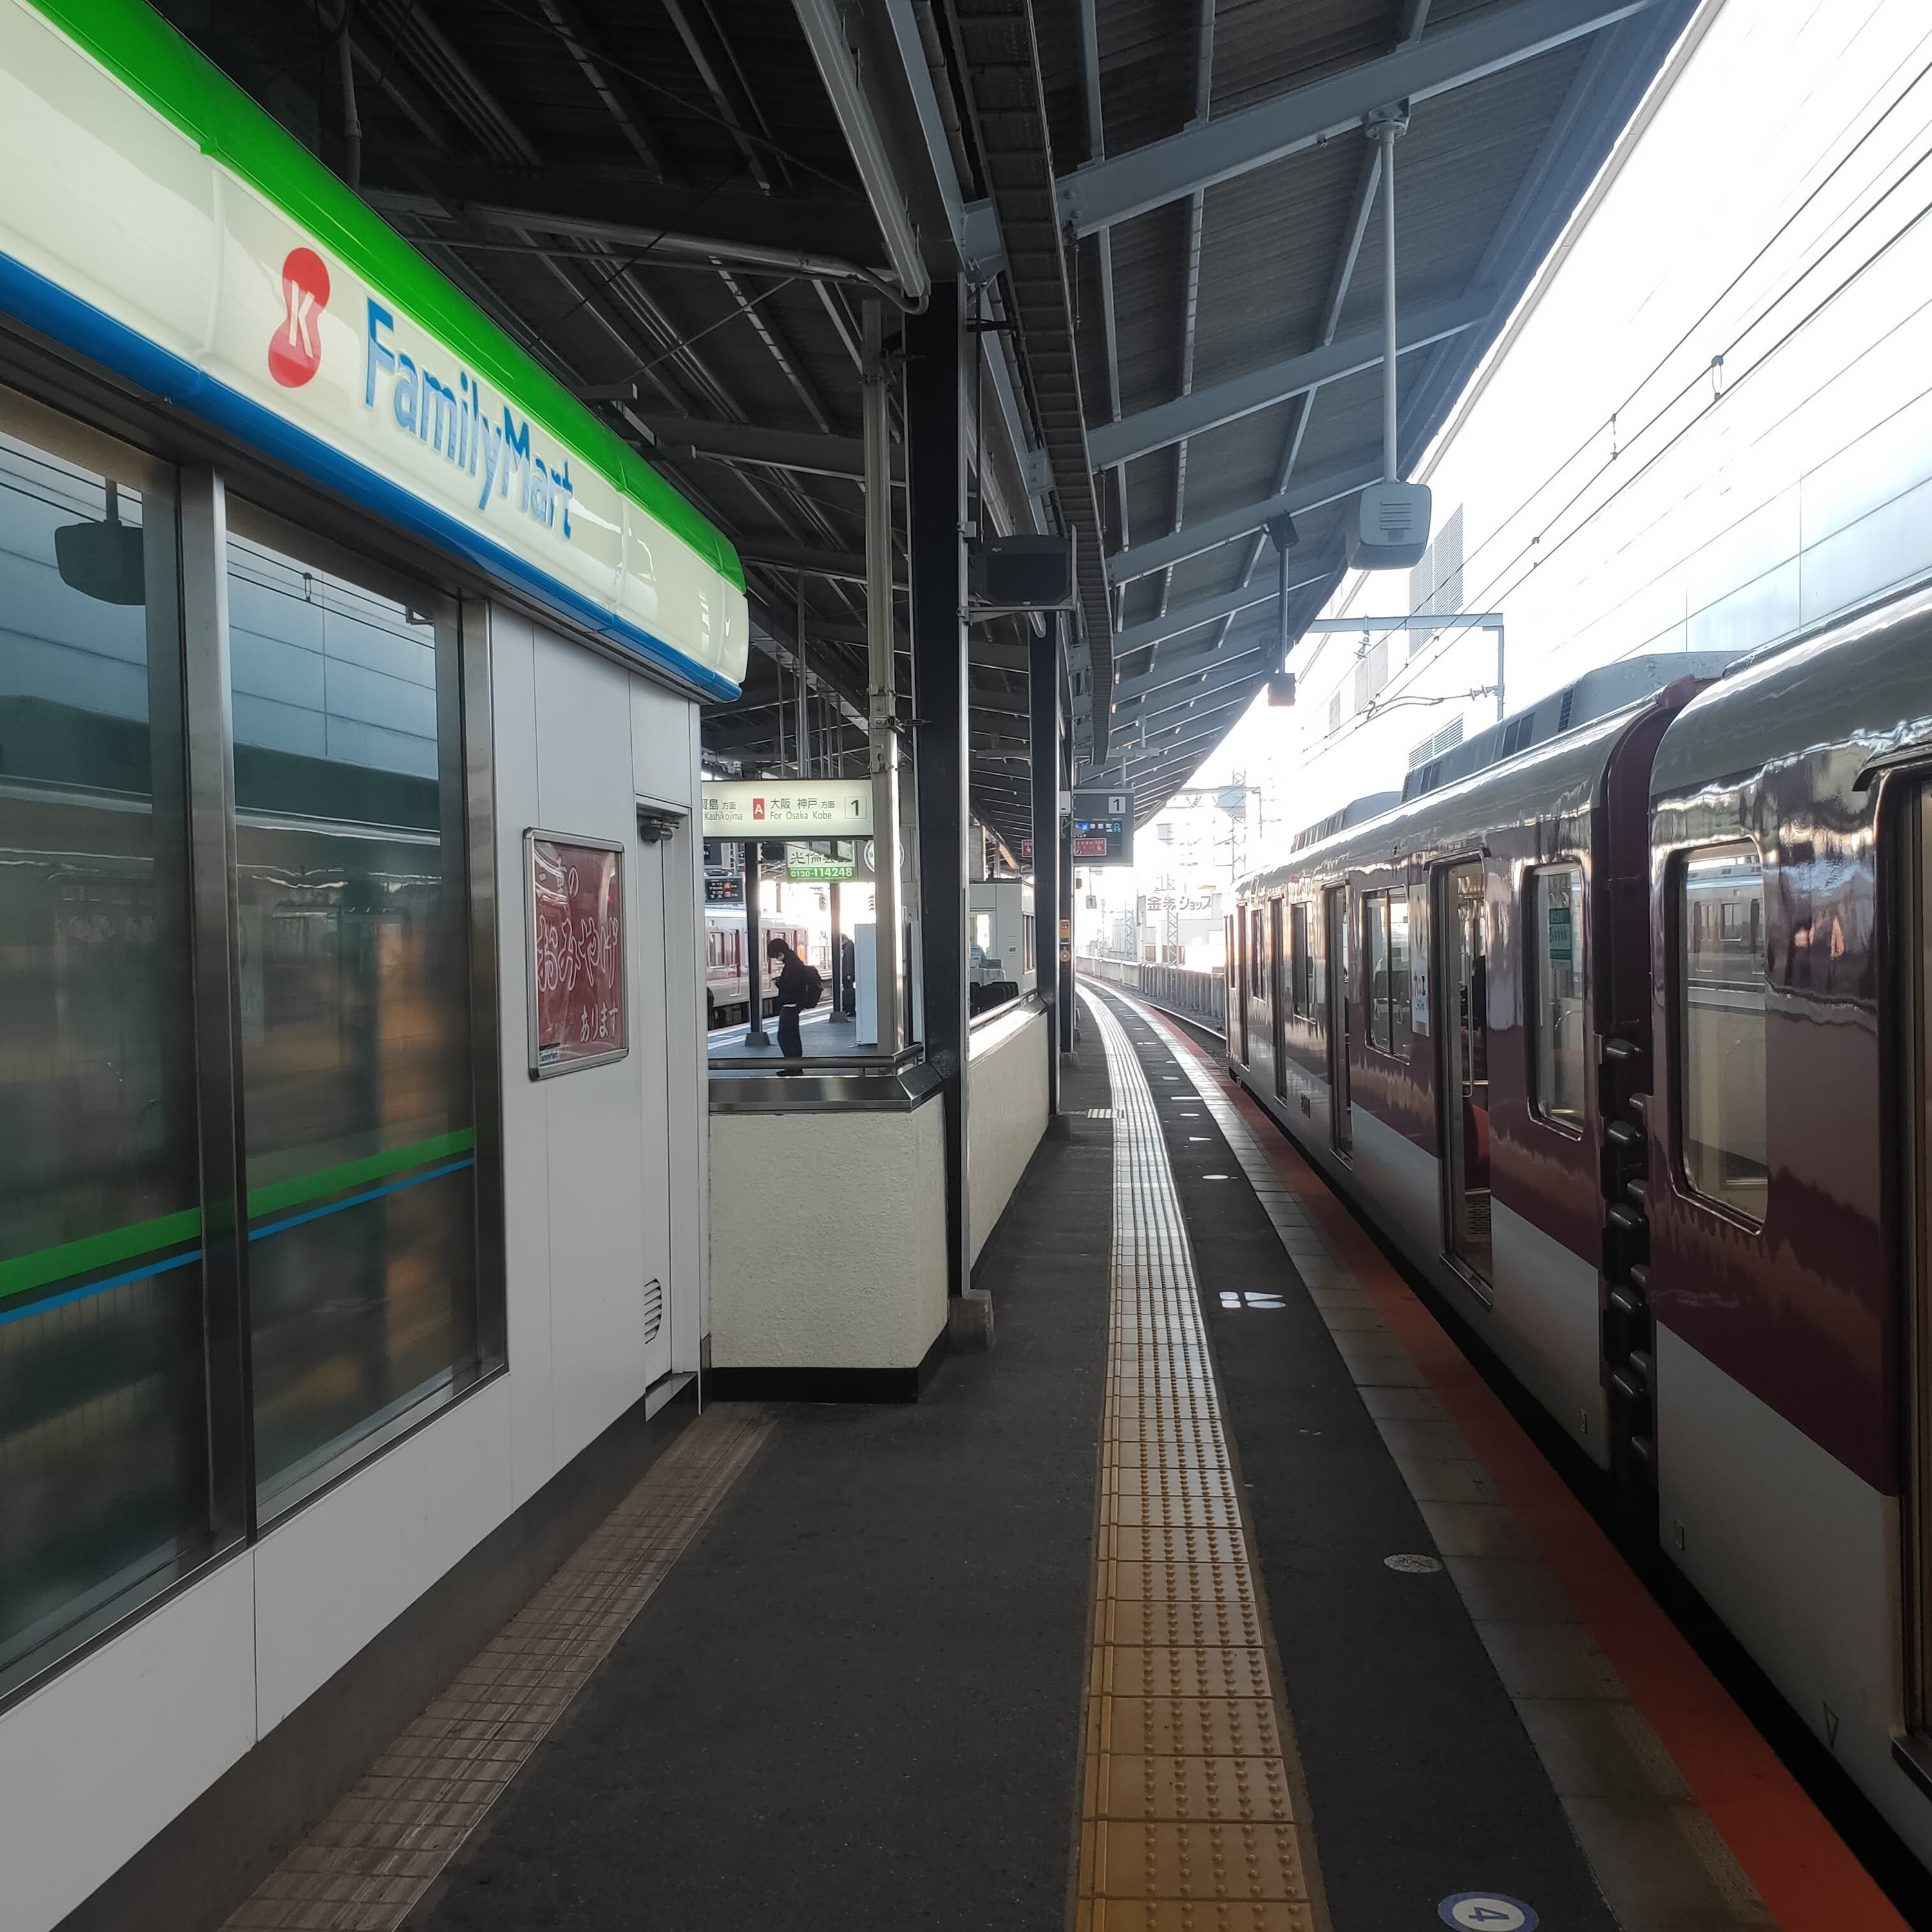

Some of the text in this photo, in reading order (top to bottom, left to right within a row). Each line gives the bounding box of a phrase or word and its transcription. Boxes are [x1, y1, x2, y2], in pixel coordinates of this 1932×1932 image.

[289, 279, 314, 359] K
[365, 295, 574, 541] FamilyMart
[722, 801, 736, 810] 方面
[754, 804, 764, 815] A
[770, 798, 791, 810] 大阪
[797, 798, 818, 810] 神戸
[851, 800, 858, 816] 1
[1113, 799, 1121, 812] 1
[705, 812, 743, 822] Kashikojima
[786, 811, 808, 820] Osaka
[791, 867, 853, 878] 0120-114248
[1088, 898, 1093, 906] 1
[537, 914, 619, 992] おみやげ
[580, 1002, 618, 1043] あります
[1468, 1906, 1510, 1922] 4
